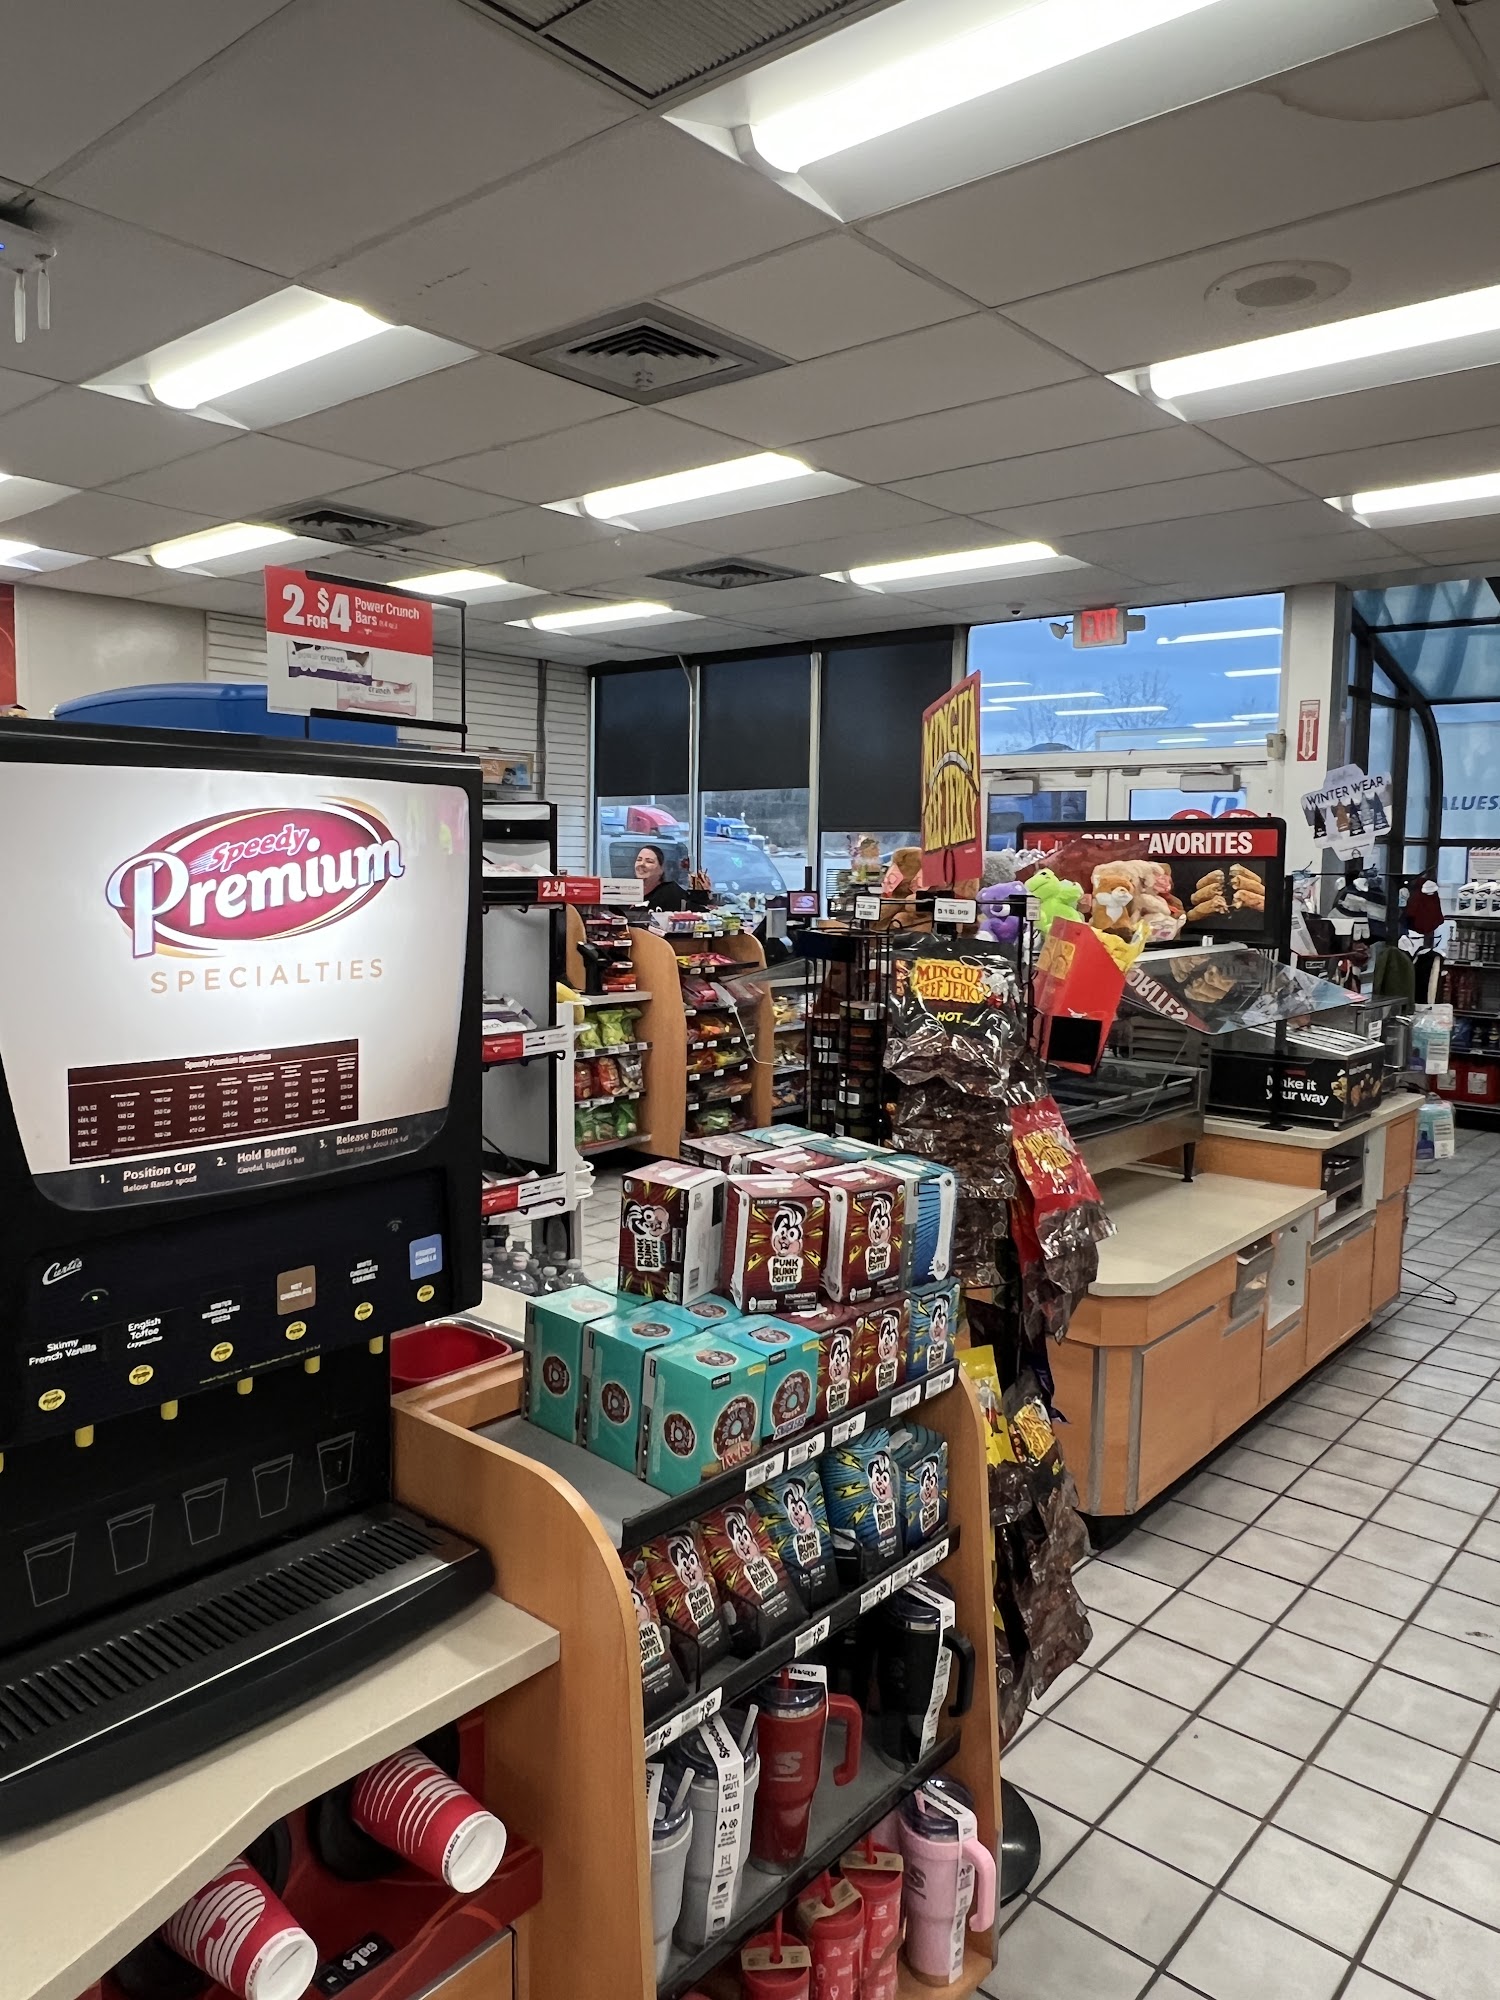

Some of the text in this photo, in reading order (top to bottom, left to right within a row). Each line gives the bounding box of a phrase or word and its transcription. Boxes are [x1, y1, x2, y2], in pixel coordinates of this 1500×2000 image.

[282, 584, 305, 626] 2
[306, 614, 329, 629] FOR
[354, 596, 420, 620] Power Crunch
[355, 610, 377, 626] Bars
[1081, 608, 1118, 642] EXIT
[922, 684, 980, 816] MINGUA
[1306, 786, 1350, 808] WINTER
[1351, 776, 1385, 793] WEAR
[210, 823, 311, 872] Speedy
[105, 838, 406, 959] Premium
[151, 958, 383, 994] SPECIALTIES
[917, 964, 983, 986] MINGUA
[918, 981, 983, 1000] BEEF JERKY
[936, 1012, 963, 1022] HOT
[1307, 1079, 1317, 1091] it
[1266, 1089, 1329, 1106] yur way
[336, 1133, 369, 1146] Release
[371, 1127, 398, 1139] Button
[216, 1146, 297, 1166] 2. Hold Button
[99, 1162, 197, 1184] 1. Position Cup
[122, 1175, 197, 1193] Below flavor spout
[636, 1238, 645, 1267] PUNK
[773, 1258, 799, 1268] PUNK
[772, 1276, 798, 1284] COFFEE
[127, 1317, 162, 1332] English
[129, 1327, 160, 1341] Toffee
[28, 1343, 97, 1366] French Vanilla
[47, 1339, 79, 1353] Skinny
[796, 1531, 818, 1543] PUNK
[747, 1557, 767, 1572] PUNK
[689, 1585, 709, 1601] PUNK
[755, 1577, 775, 1592] COFFEE
[639, 1624, 656, 1641] UNK
